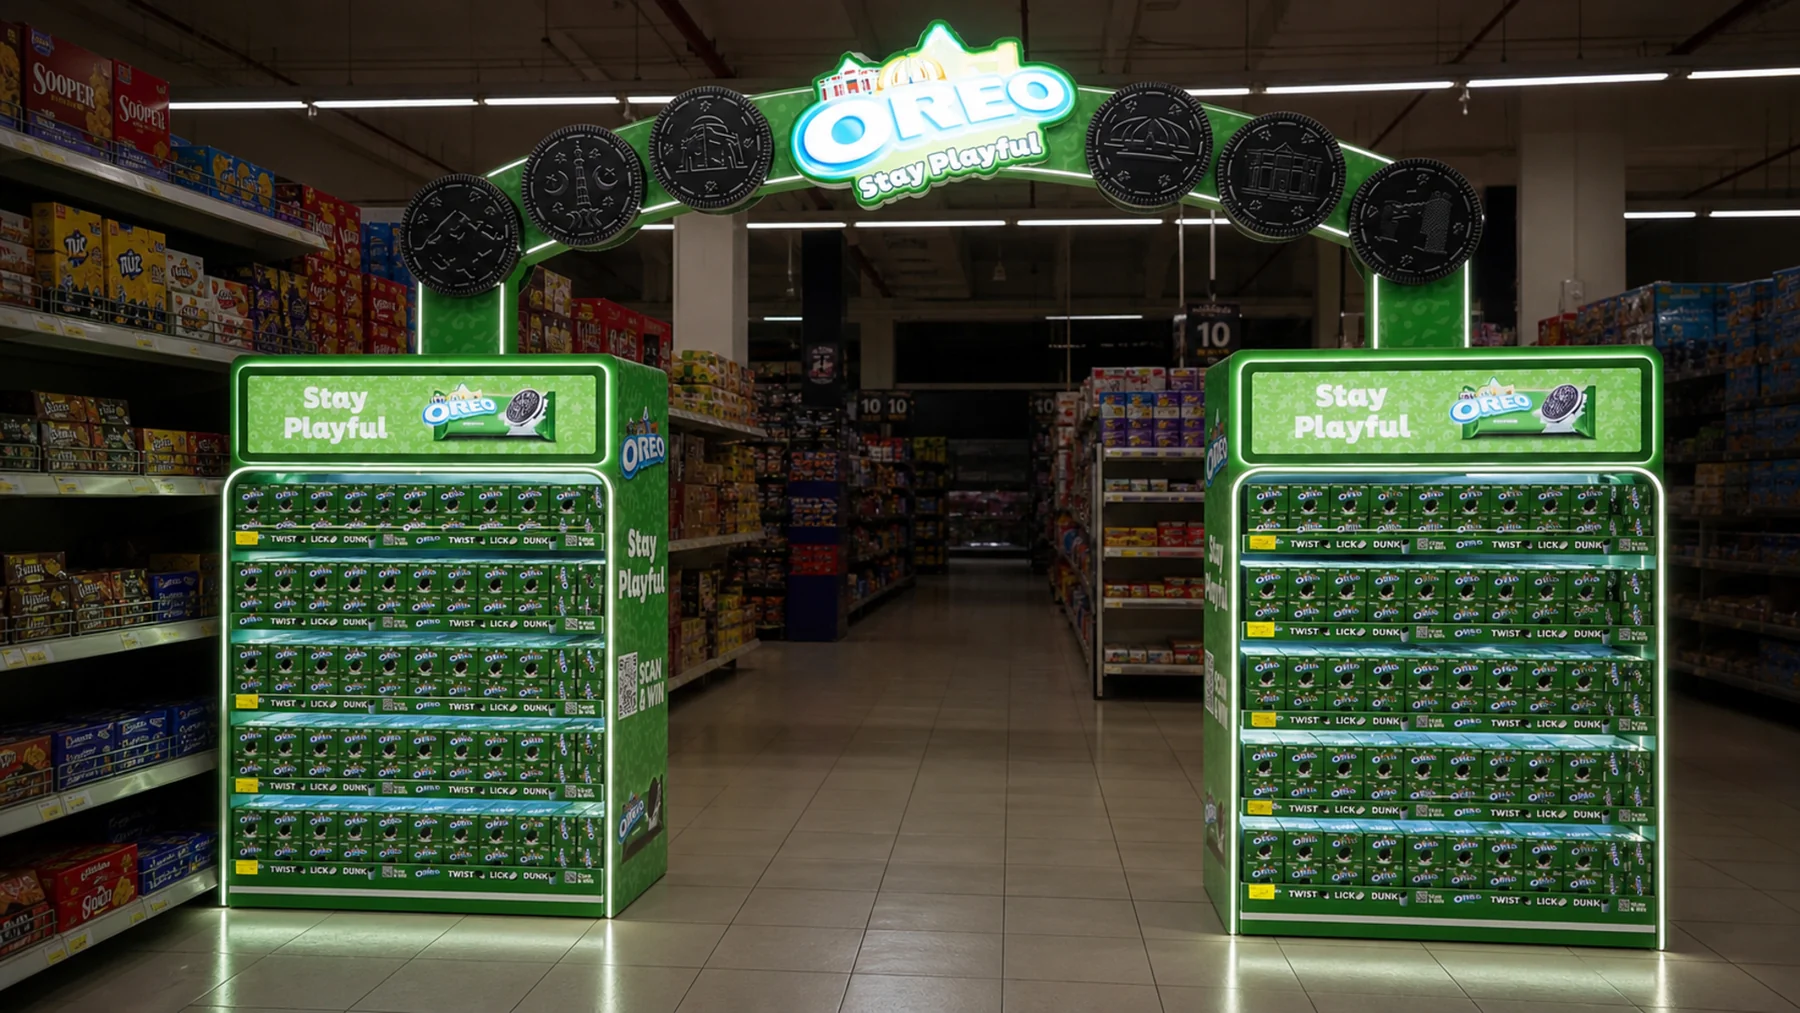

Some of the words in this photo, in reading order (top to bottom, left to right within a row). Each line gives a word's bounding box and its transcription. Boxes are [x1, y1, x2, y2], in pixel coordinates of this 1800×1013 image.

[32, 61, 96, 109] SOOPER
[800, 68, 1072, 168] OREO
[858, 161, 924, 200] Stay
[927, 131, 1042, 176] Playful
[1196, 321, 1231, 348] 10
[303, 386, 368, 415] Stay
[861, 398, 882, 414] 10
[887, 398, 908, 414] 10
[1315, 383, 1388, 412] Stay
[1450, 395, 1531, 423] OREO
[424, 398, 497, 426] OREO
[284, 416, 388, 445] Playful
[1294, 415, 1411, 445] Playful
[622, 435, 665, 473] OREO
[271, 535, 297, 543] TWIST
[311, 535, 331, 543] LICK
[448, 536, 475, 544] TWIST
[490, 537, 509, 545] LICK
[523, 537, 549, 545] DUNK
[628, 528, 657, 563] Stay
[1290, 540, 1320, 548] TWIST
[1336, 540, 1358, 549] LICK
[1373, 540, 1401, 549] DUNK
[1492, 540, 1522, 549] TWIST
[1538, 541, 1559, 549] LICK
[1574, 541, 1602, 549] DUNK
[618, 566, 666, 604] Playful
[343, 618, 368, 626] DUNK
[449, 619, 475, 627] TWIST
[490, 620, 509, 628] LICK
[523, 620, 549, 628] DUNK
[1289, 627, 1319, 636] TWIST
[1336, 627, 1357, 636] LICK
[1373, 628, 1400, 636] DUNK
[1491, 629, 1521, 637] TWIST
[1537, 630, 1558, 638] LICK
[1574, 630, 1602, 638] DUNK
[639, 657, 662, 685] SCAN
[270, 699, 296, 707] TWIST
[310, 700, 329, 708] LICK
[523, 704, 549, 712] DUNK
[639, 688, 646, 712] &
[647, 681, 665, 709] WIN
[1289, 716, 1319, 724] TWIST
[1336, 716, 1356, 725] LICK
[1373, 717, 1400, 725] DUNK
[1491, 719, 1521, 727] TWIST
[1537, 720, 1558, 728] LICK
[1574, 720, 1601, 728] DUNK
[270, 782, 296, 790] TWIST
[310, 783, 329, 791] LICK
[343, 783, 367, 791] DUNK
[448, 786, 475, 794] TWIST
[490, 787, 509, 795] LICK
[523, 787, 549, 795] DUNK
[1289, 804, 1318, 813] TWIST
[1335, 805, 1356, 814] LICK
[1372, 806, 1399, 814] DUNK
[1490, 809, 1521, 818] TWIST
[1536, 810, 1558, 818] LICK
[1573, 810, 1601, 819] DUNK
[270, 865, 296, 873] TWIST
[310, 866, 329, 874] LICK
[343, 867, 367, 875] DUNK
[448, 870, 475, 878] TWIST
[490, 871, 509, 879] LICK
[523, 872, 548, 880] DUNK
[1288, 890, 1318, 899] TWIST
[1334, 891, 1355, 899] LICK
[1371, 891, 1399, 900] DUNK
[1490, 896, 1520, 904] TWIST
[1536, 897, 1558, 906] LICK
[1573, 898, 1600, 907] DUNK
